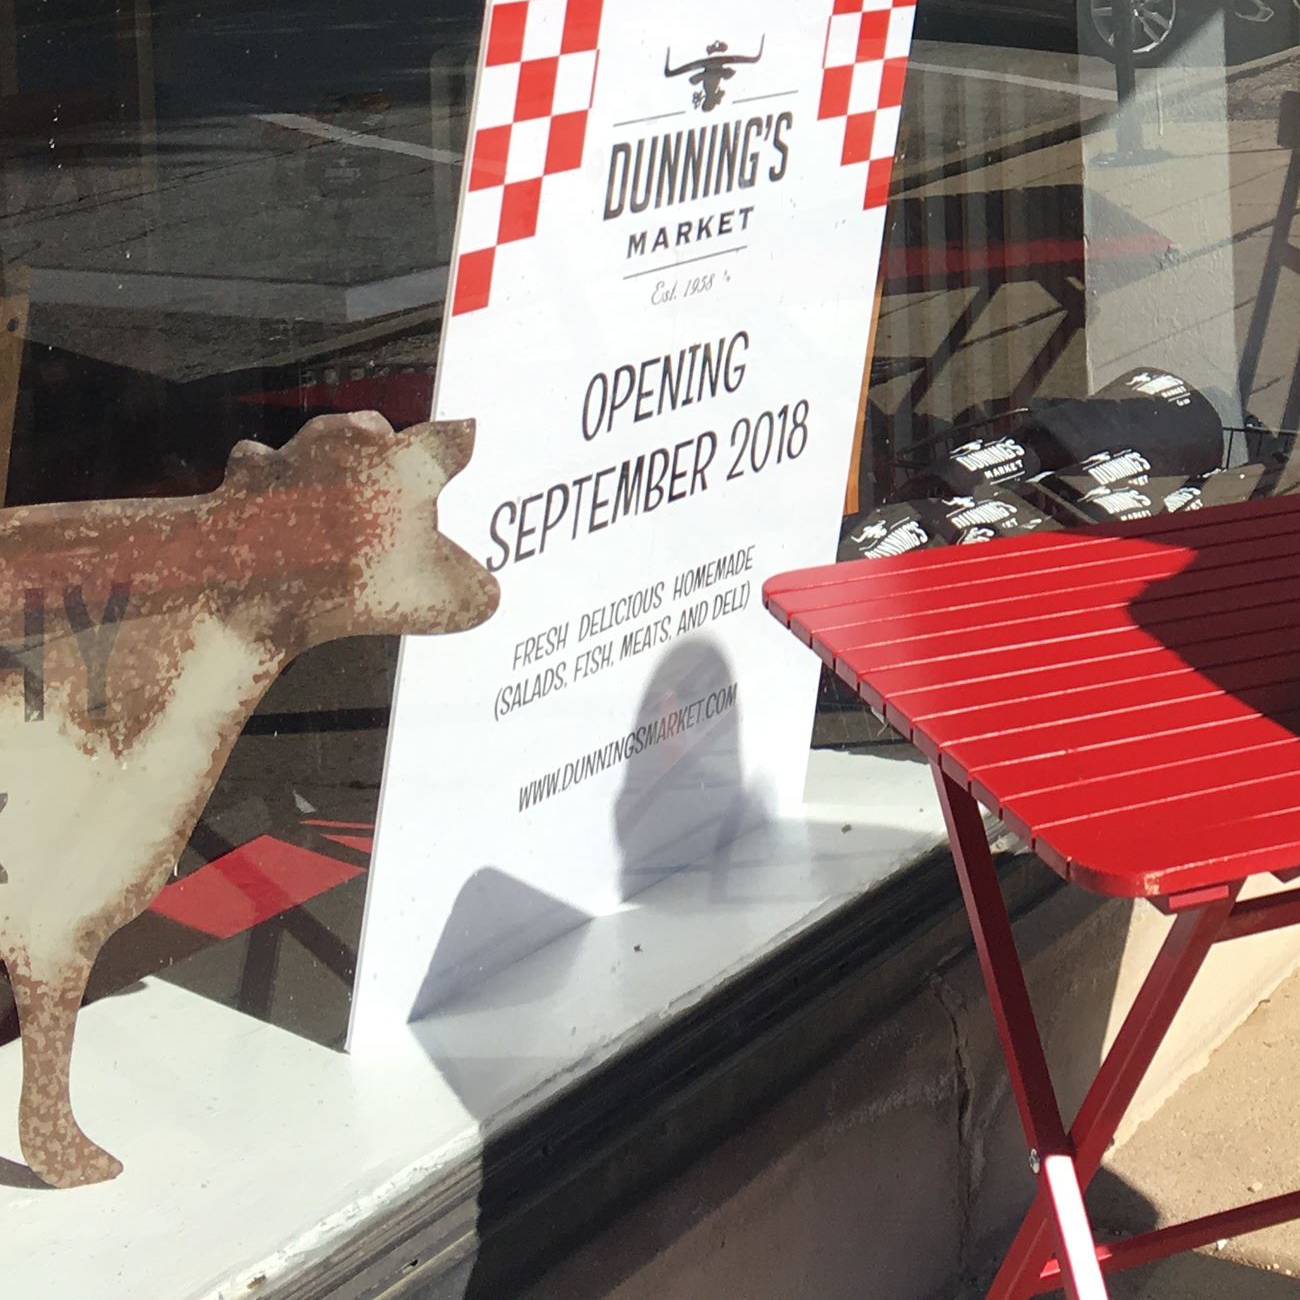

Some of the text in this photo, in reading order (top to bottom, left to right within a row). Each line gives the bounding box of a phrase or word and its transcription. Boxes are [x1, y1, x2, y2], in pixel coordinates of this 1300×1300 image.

[602, 111, 793, 221] DUNNING'S
[626, 206, 755, 259] MARKET
[683, 273, 716, 298] 1958
[581, 330, 750, 442] OPENING
[486, 398, 810, 573] SEPTEMBER 2018
[512, 545, 756, 672] FRESH DELICIOUS HOMEMADE
[573, 640, 615, 683] FISH,
[619, 616, 672, 664] MEATS,
[676, 600, 708, 637] AND
[711, 580, 752, 620] DELI)
[517, 683, 738, 812] WWW.DUNNINGSMARKET.COM
